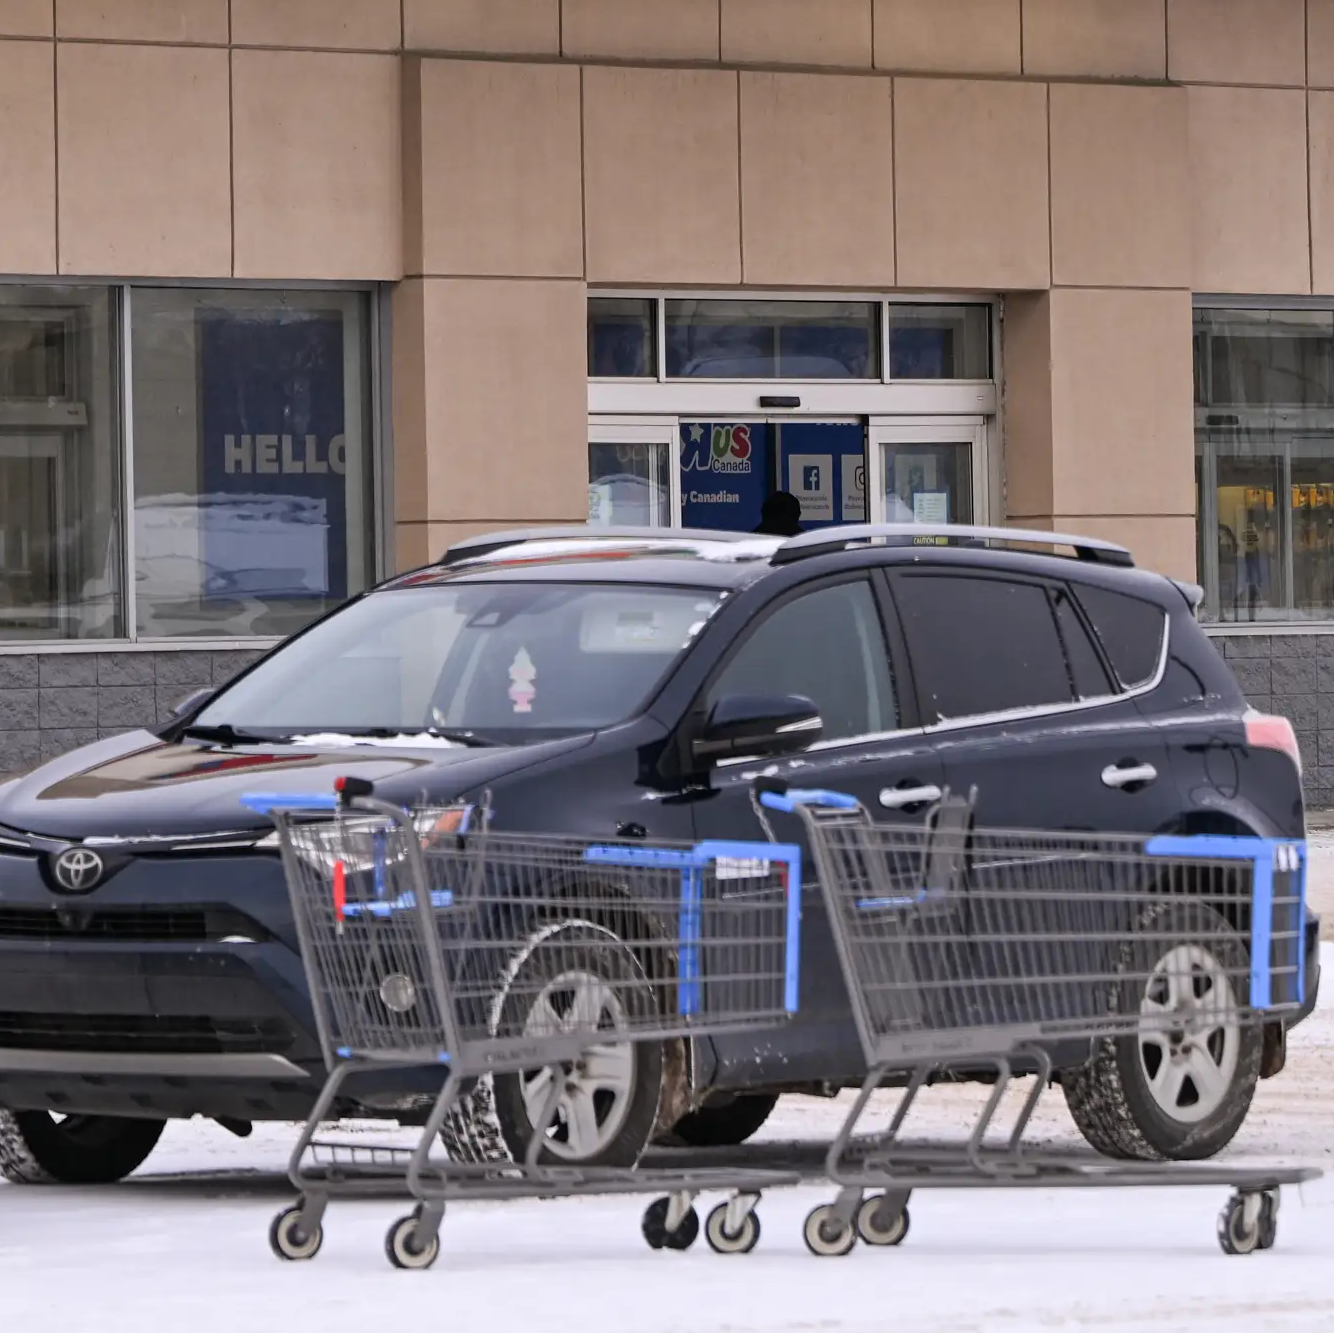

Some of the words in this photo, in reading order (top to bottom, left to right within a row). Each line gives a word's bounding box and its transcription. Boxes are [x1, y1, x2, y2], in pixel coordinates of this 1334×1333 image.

[712, 425, 752, 459] US
[712, 458, 751, 472] Canada
[689, 489, 740, 503] Canadian
